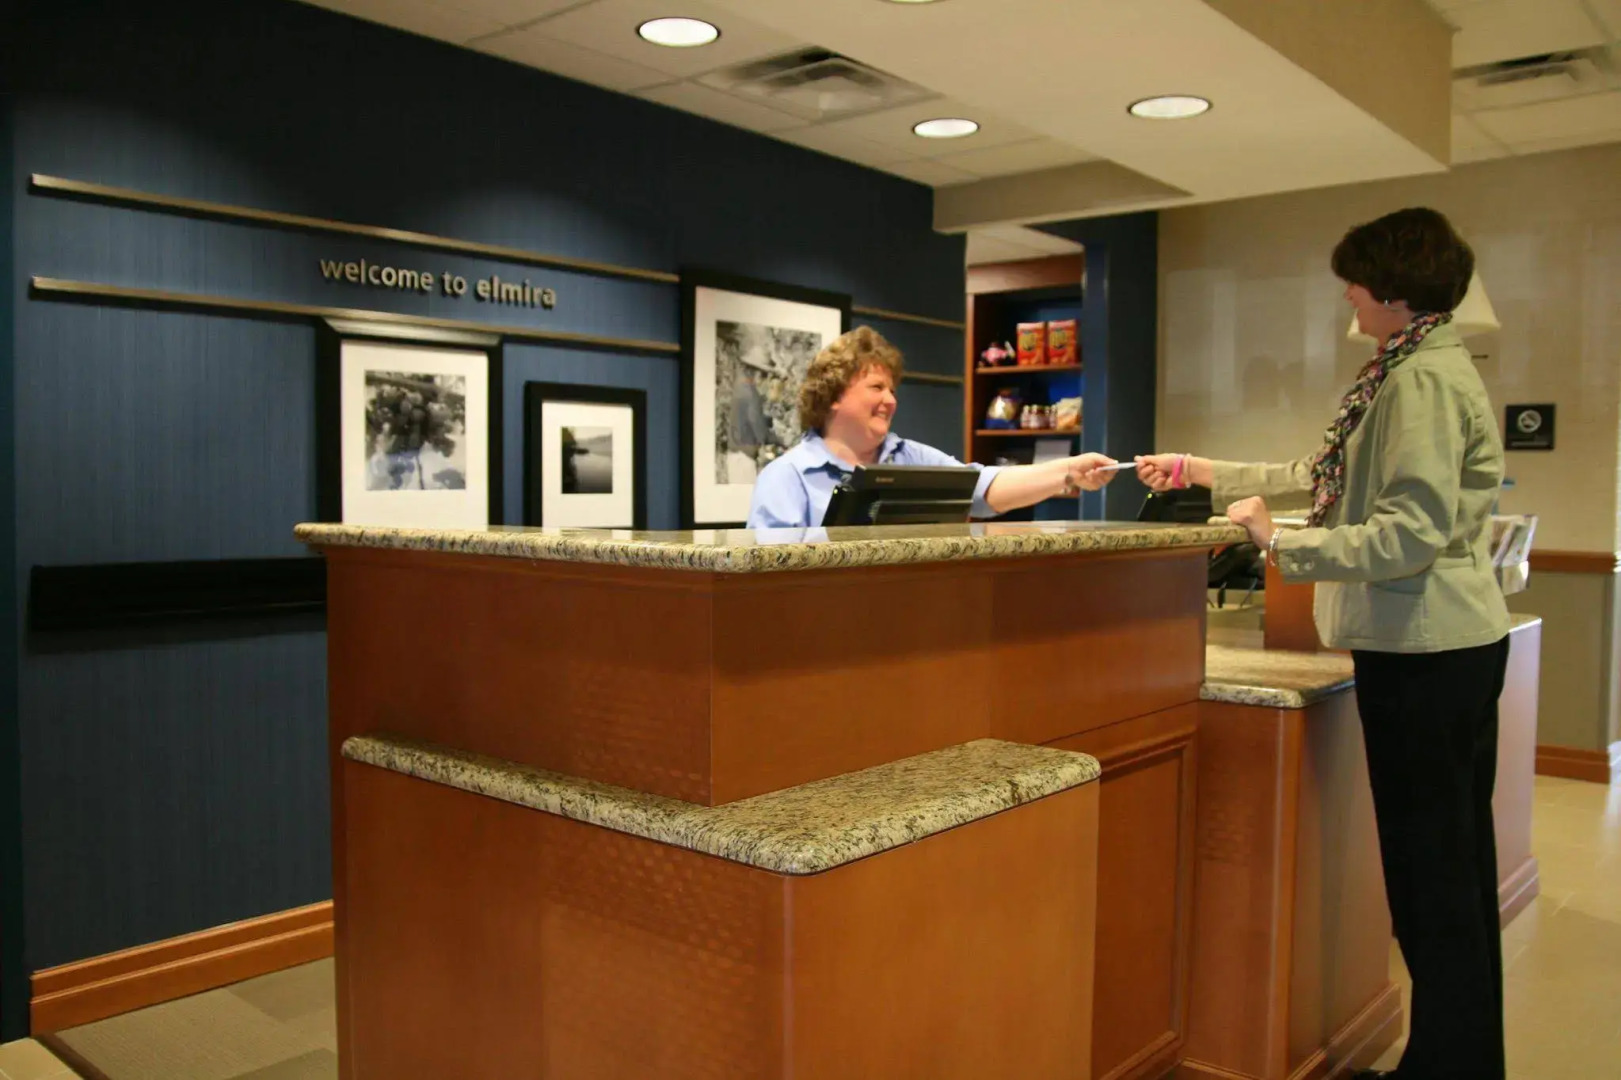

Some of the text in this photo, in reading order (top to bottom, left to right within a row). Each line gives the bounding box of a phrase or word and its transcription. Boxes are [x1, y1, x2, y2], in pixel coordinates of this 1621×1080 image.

[319, 258, 557, 307] welcome to elmira
